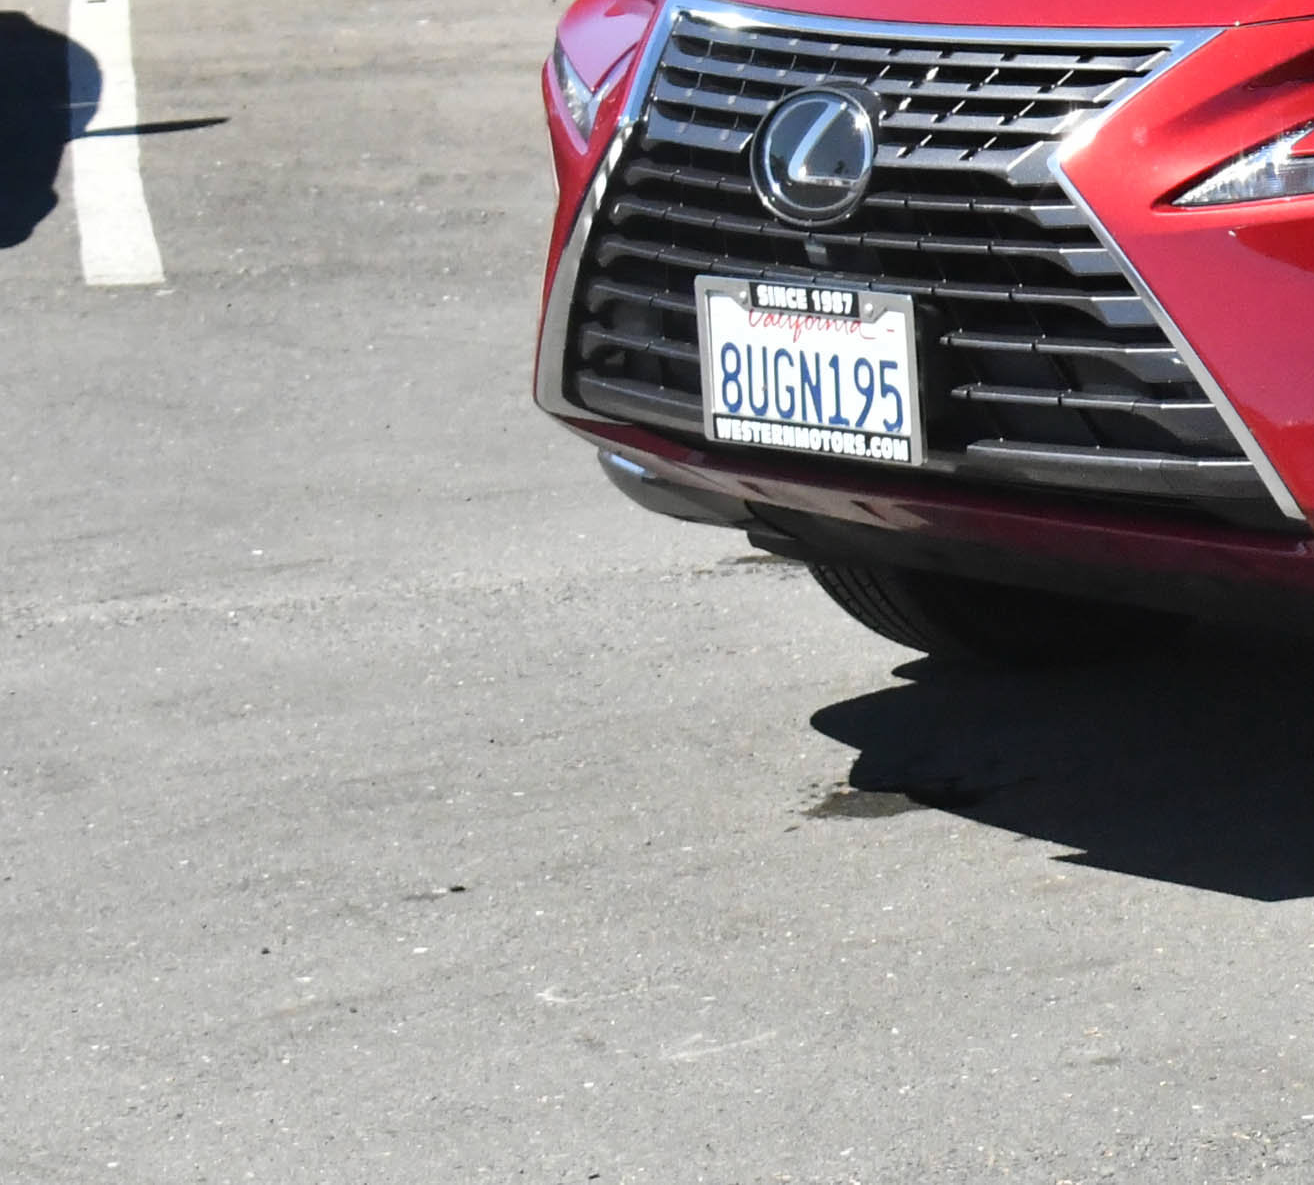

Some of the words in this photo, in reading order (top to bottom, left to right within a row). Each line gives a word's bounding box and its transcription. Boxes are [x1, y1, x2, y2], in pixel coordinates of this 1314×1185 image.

[756, 284, 808, 310] SINCE
[811, 289, 854, 315] 1987
[720, 342, 904, 433] 8UGN195
[715, 416, 910, 463] WESTERNMOTORS.COM
